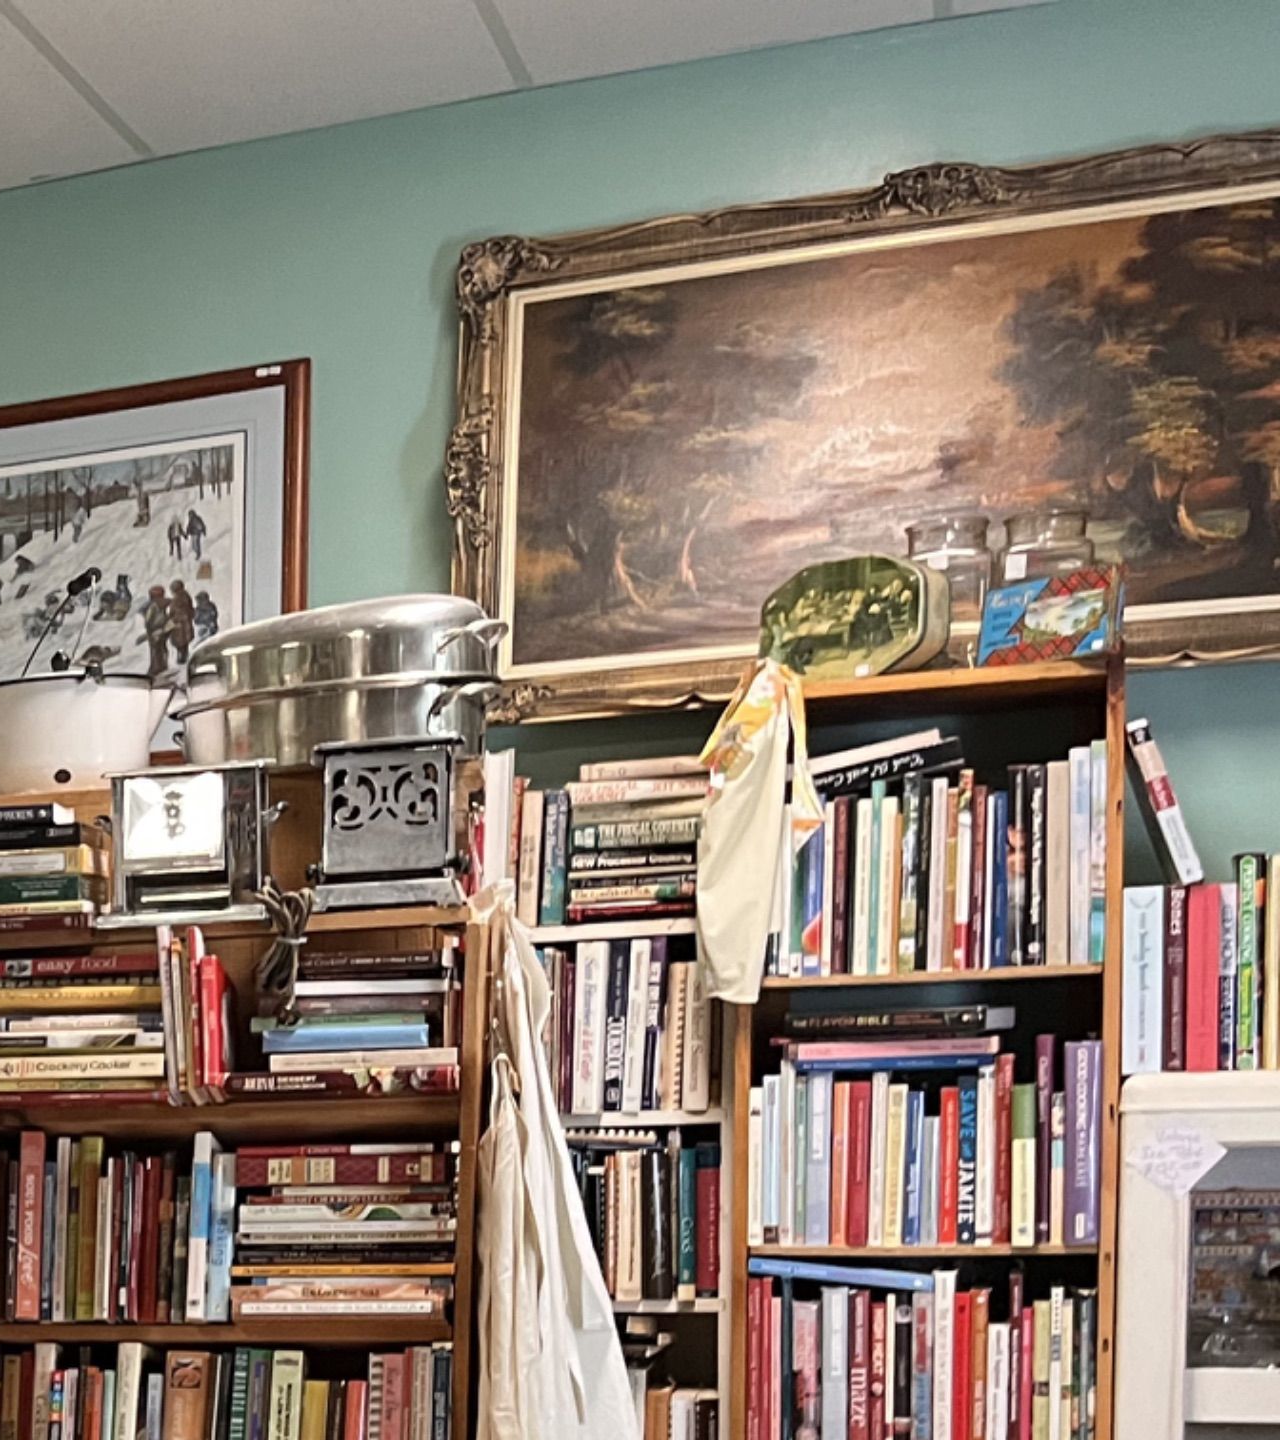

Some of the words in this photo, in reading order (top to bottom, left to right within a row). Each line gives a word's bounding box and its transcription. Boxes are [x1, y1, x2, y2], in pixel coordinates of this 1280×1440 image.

[1171, 888, 1185, 936] Bones
[37, 959, 74, 974] easy
[81, 956, 118, 970] food
[857, 1014, 890, 1027] BIBLE
[36, 1060, 88, 1072] Crockery
[89, 1060, 131, 1071] Cooker
[960, 1089, 976, 1138] SAVE
[25, 1174, 36, 1209] SOUL
[958, 1159, 975, 1225] JAMIE
[23, 1211, 34, 1250] FOOD
[211, 1217, 228, 1267] Baking
[851, 1367, 868, 1428] maze
